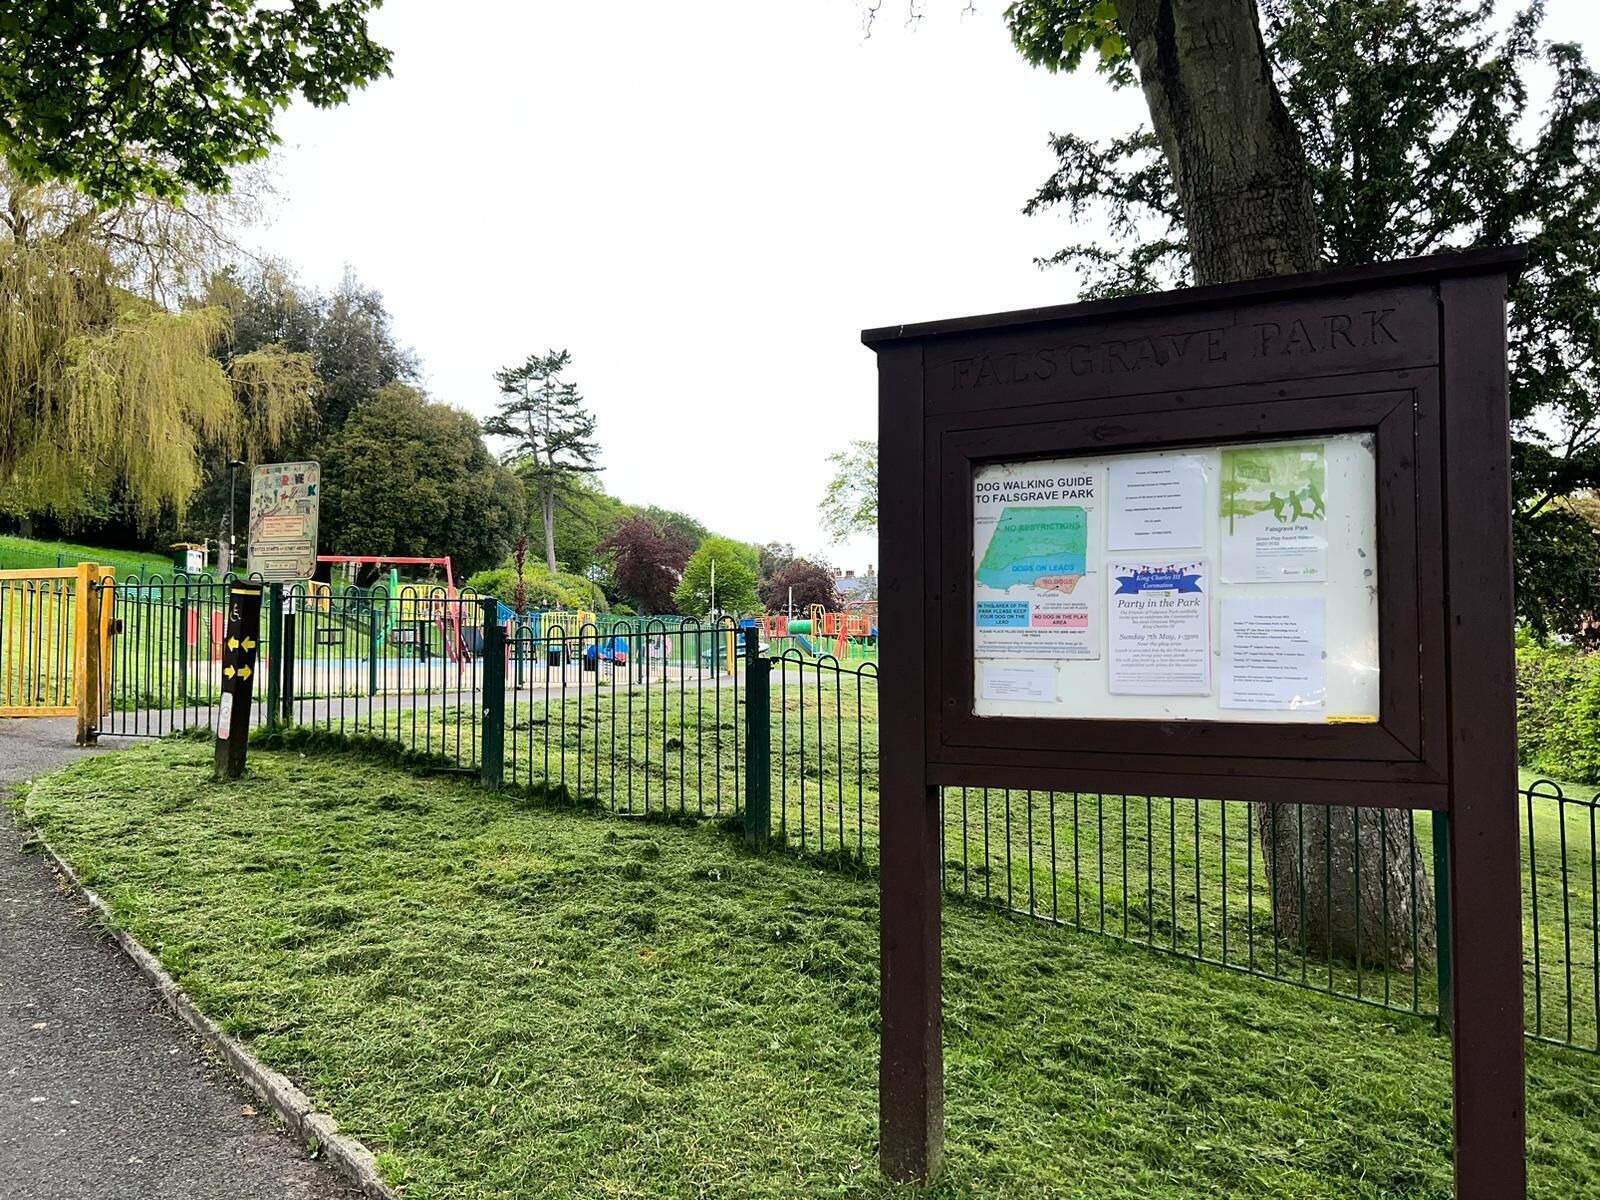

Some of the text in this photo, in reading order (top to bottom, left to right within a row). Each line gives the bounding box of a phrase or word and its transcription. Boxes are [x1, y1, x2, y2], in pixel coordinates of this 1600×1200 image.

[951, 308, 1398, 391] FALSGRAVE PARK
[976, 476, 1093, 492] DOG WALKING GUIDE
[975, 489, 1094, 504] TO FALSGRAVE PARK
[1004, 522, 1081, 532] NO RESTRICTIONS
[1265, 525, 1294, 533] Falsgrave
[1117, 597, 1201, 609] Party in the Park
[1119, 633, 1146, 641] Sunday
